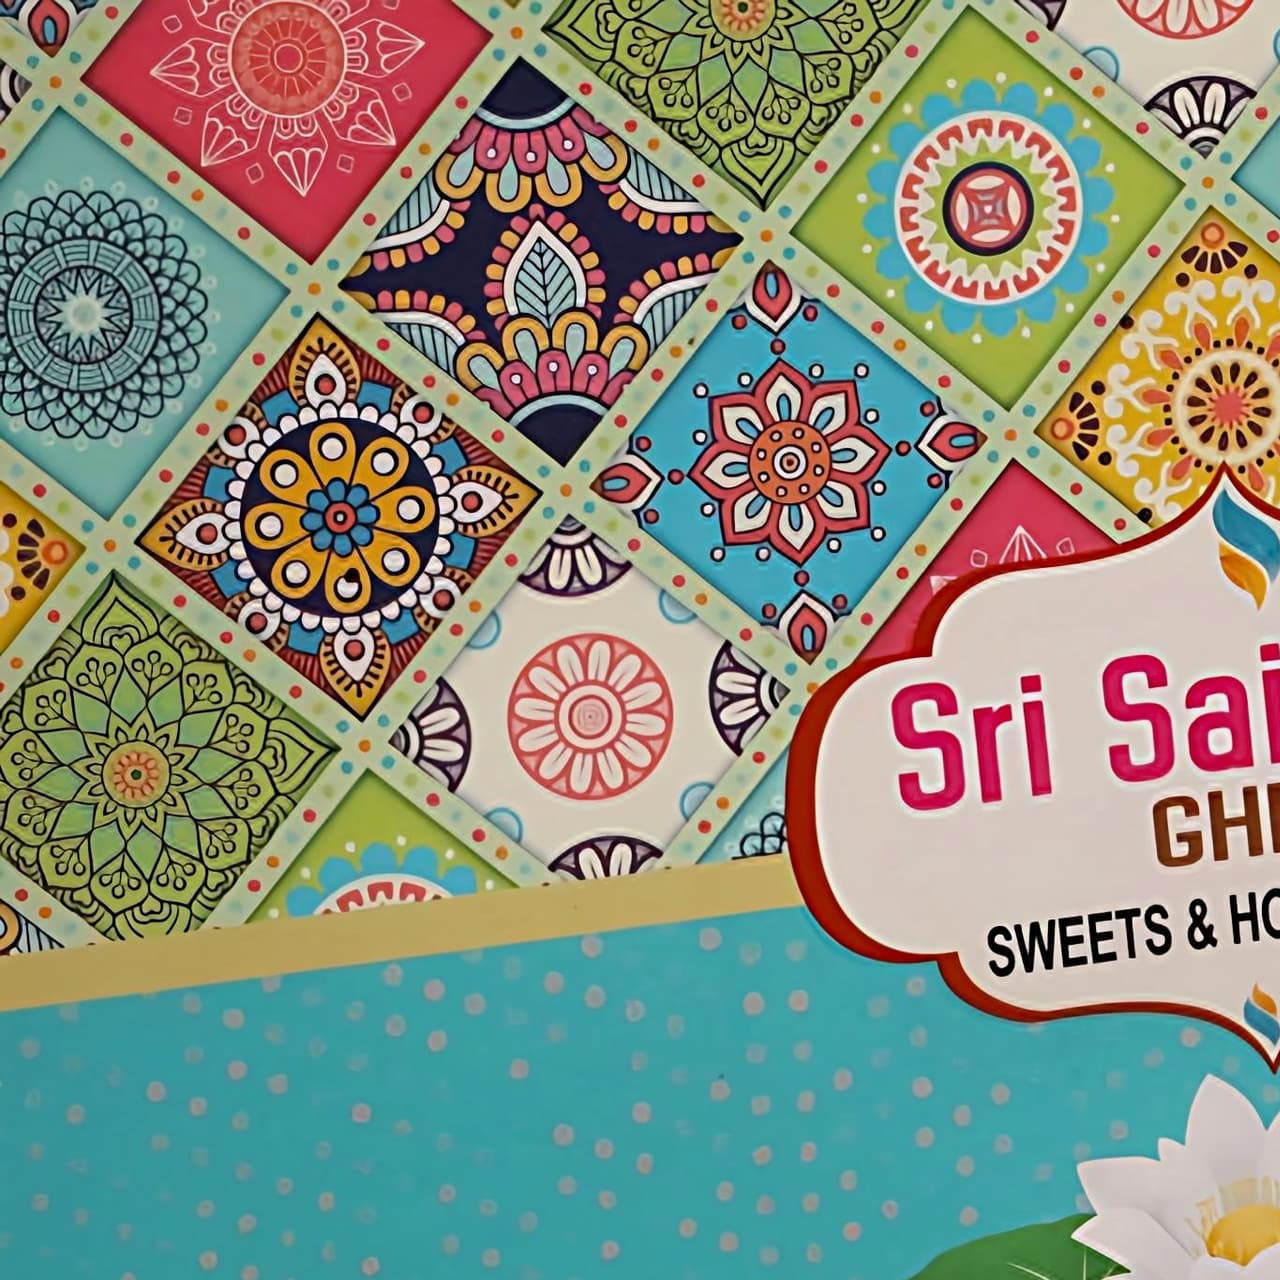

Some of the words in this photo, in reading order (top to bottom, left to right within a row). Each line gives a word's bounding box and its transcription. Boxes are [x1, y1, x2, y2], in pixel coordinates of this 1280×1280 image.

[891, 674, 1053, 811] Sri
[986, 903, 1173, 978] SWEETS
[1186, 902, 1219, 951] &
